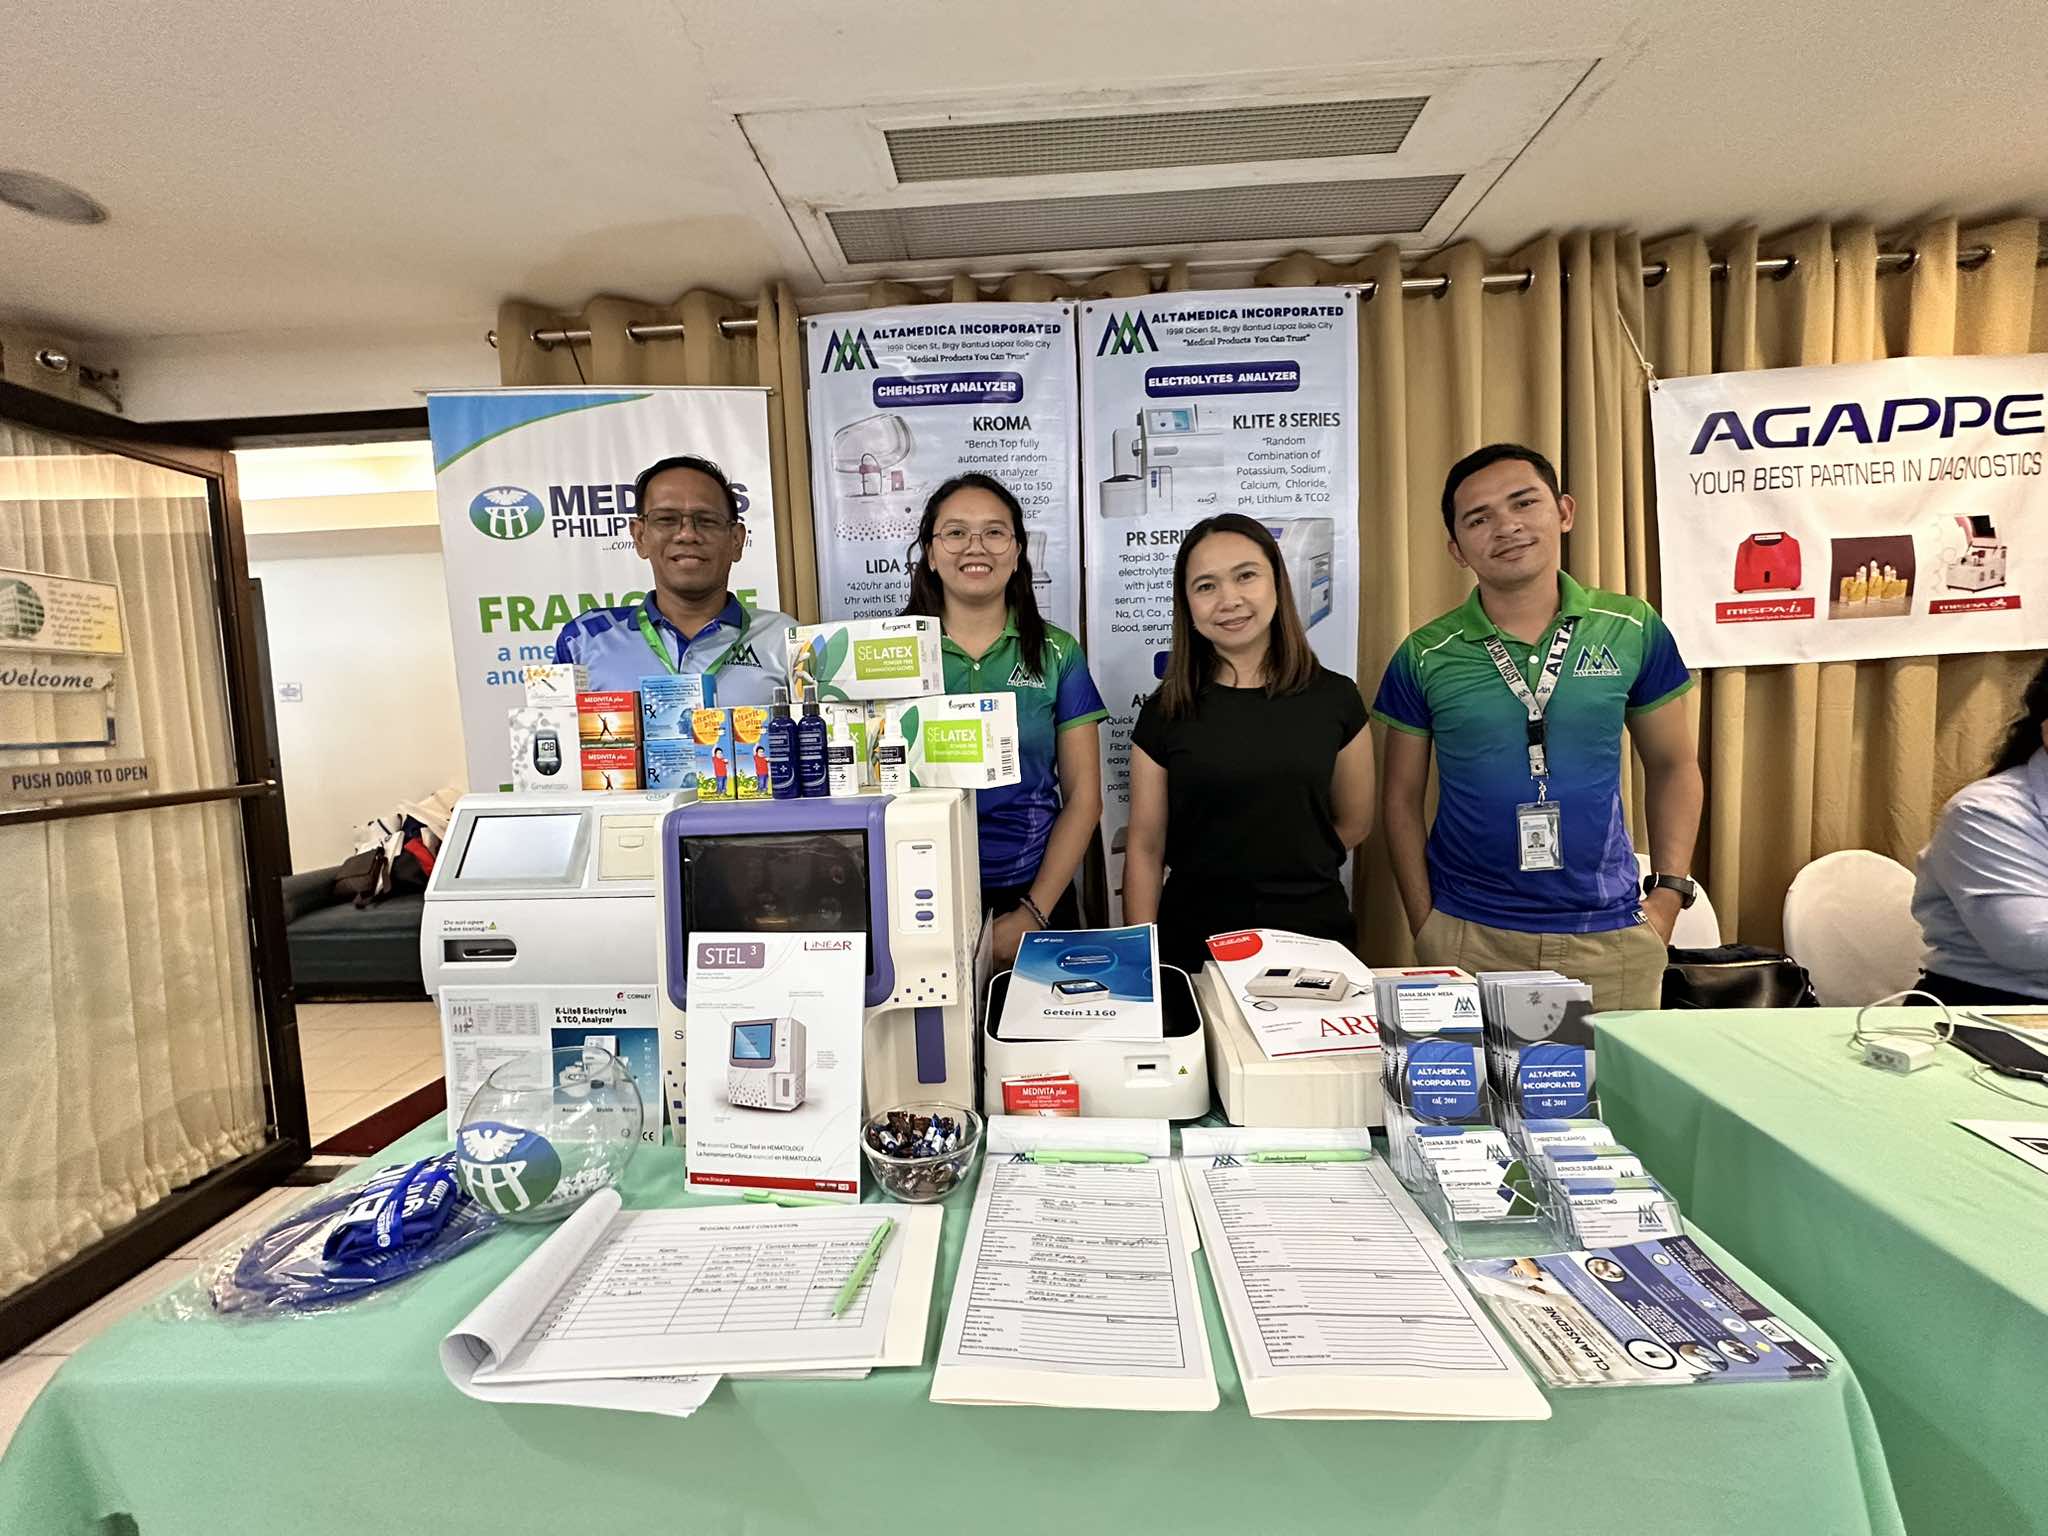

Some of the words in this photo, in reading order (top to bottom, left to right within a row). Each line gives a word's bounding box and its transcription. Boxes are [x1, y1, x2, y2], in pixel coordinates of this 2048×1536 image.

[1151, 310, 1239, 325] ALTAMEDICA
[1241, 306, 1345, 319] INCORPORATED
[873, 325, 957, 340] ALTAMEDICA
[960, 323, 1062, 336] INCORPORATED
[1148, 373, 1234, 388] ELECTROLYTES
[1238, 371, 1298, 383] ANALYZER
[877, 383, 948, 398] CHEMISTRY
[951, 381, 1017, 394] ANALYZER
[972, 416, 1032, 432] KROMA
[1232, 413, 1276, 430] KLITE
[1278, 413, 1288, 428] 8
[1290, 412, 1342, 428] SERIES
[1688, 393, 2046, 455] AGAPPE
[1000, 438, 1018, 450] Top
[1020, 437, 1040, 450] fully
[958, 454, 1009, 464] automated
[1011, 453, 1048, 463] random
[1247, 450, 1309, 462] Combination
[1310, 449, 1321, 460] of
[1000, 468, 1039, 479] analyzer
[1236, 465, 1288, 477] Potassium,
[1690, 469, 1746, 496] YOUR
[1753, 465, 1805, 492] BEST
[1811, 459, 1896, 488] PARTNER
[1903, 457, 1922, 482] IN
[1928, 451, 2043, 482] DIAGNOSTICS
[1009, 483, 1022, 493] up
[1024, 482, 1034, 491] to
[1036, 481, 1053, 491] 150
[1240, 480, 1281, 490] Calcium,
[1285, 479, 1328, 489] Chloride,
[1020, 496, 1031, 505] to
[1032, 495, 1050, 505] 250
[1257, 494, 1293, 504] Lithium
[1294, 494, 1303, 503] &
[1304, 493, 1331, 503] TCO2
[1126, 531, 1148, 547] PR
[865, 559, 901, 574] LIDA
[884, 580, 902, 590] and
[1124, 581, 1146, 591] with
[1146, 580, 1165, 592] just
[862, 594, 882, 604] with
[1114, 596, 1146, 606] serum
[853, 609, 893, 620] positions
[1111, 624, 1141, 633] Blood,
[497, 647, 512, 661] a
[1498, 658, 1522, 687] TRUST
[1111, 728, 1125, 738] for
[12, 773, 51, 791] PUSH
[56, 770, 92, 787] DOOR
[97, 768, 113, 784] TO
[116, 766, 149, 782] OPEN
[704, 947, 746, 965] STEL
[582, 1007, 627, 1016] Electrolytes
[1043, 1008, 1083, 1018] Getein
[1085, 1008, 1117, 1018] 1160
[582, 1016, 614, 1025] Analyzer
[1417, 1067, 1467, 1076] ALTAMEDICA
[1528, 1070, 1577, 1079] ALTAMEDICA
[1412, 1079, 1472, 1088] INCORPORATED
[1523, 1081, 1581, 1090] INCORPORATED
